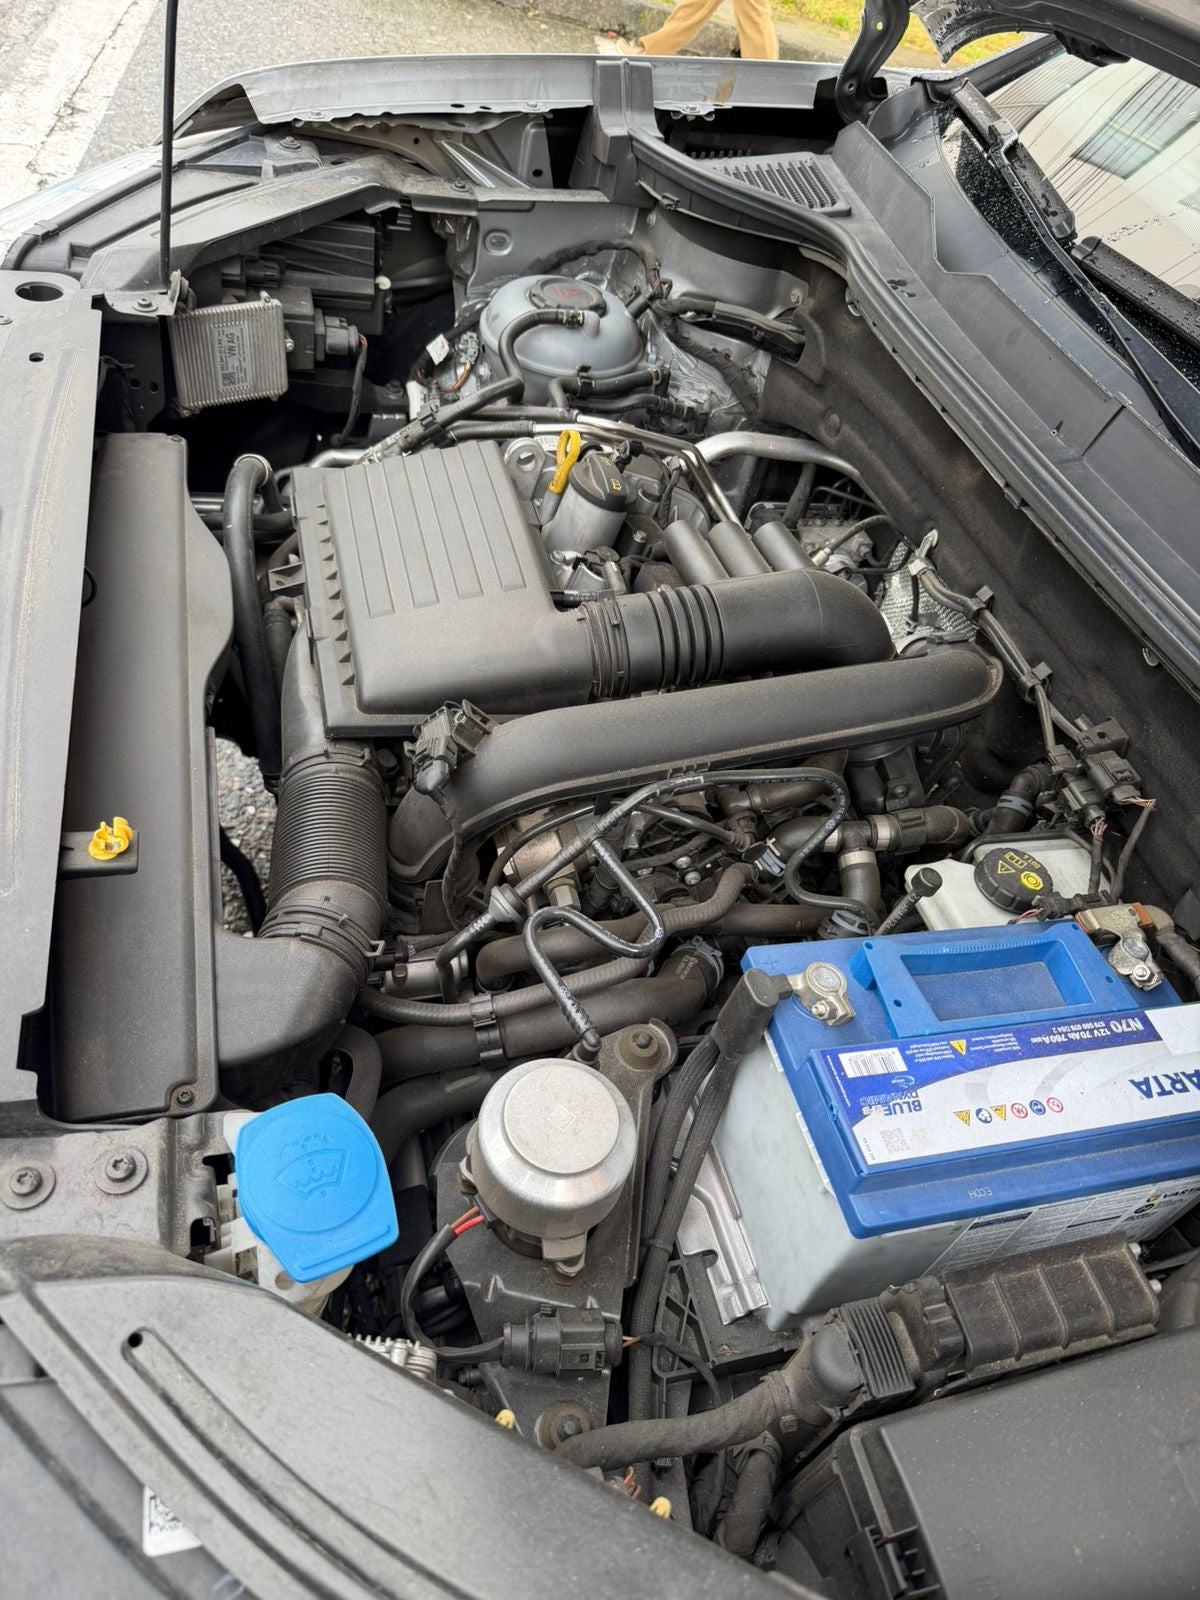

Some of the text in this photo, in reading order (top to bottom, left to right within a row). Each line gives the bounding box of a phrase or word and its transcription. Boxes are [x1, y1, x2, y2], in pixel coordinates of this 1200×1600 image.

[225, 332, 235, 344] AG
[227, 344, 236, 357] VW
[1109, 1016, 1144, 1033] N70
[1093, 1027, 1111, 1037] 12V
[881, 1099, 922, 1116] BLUE
